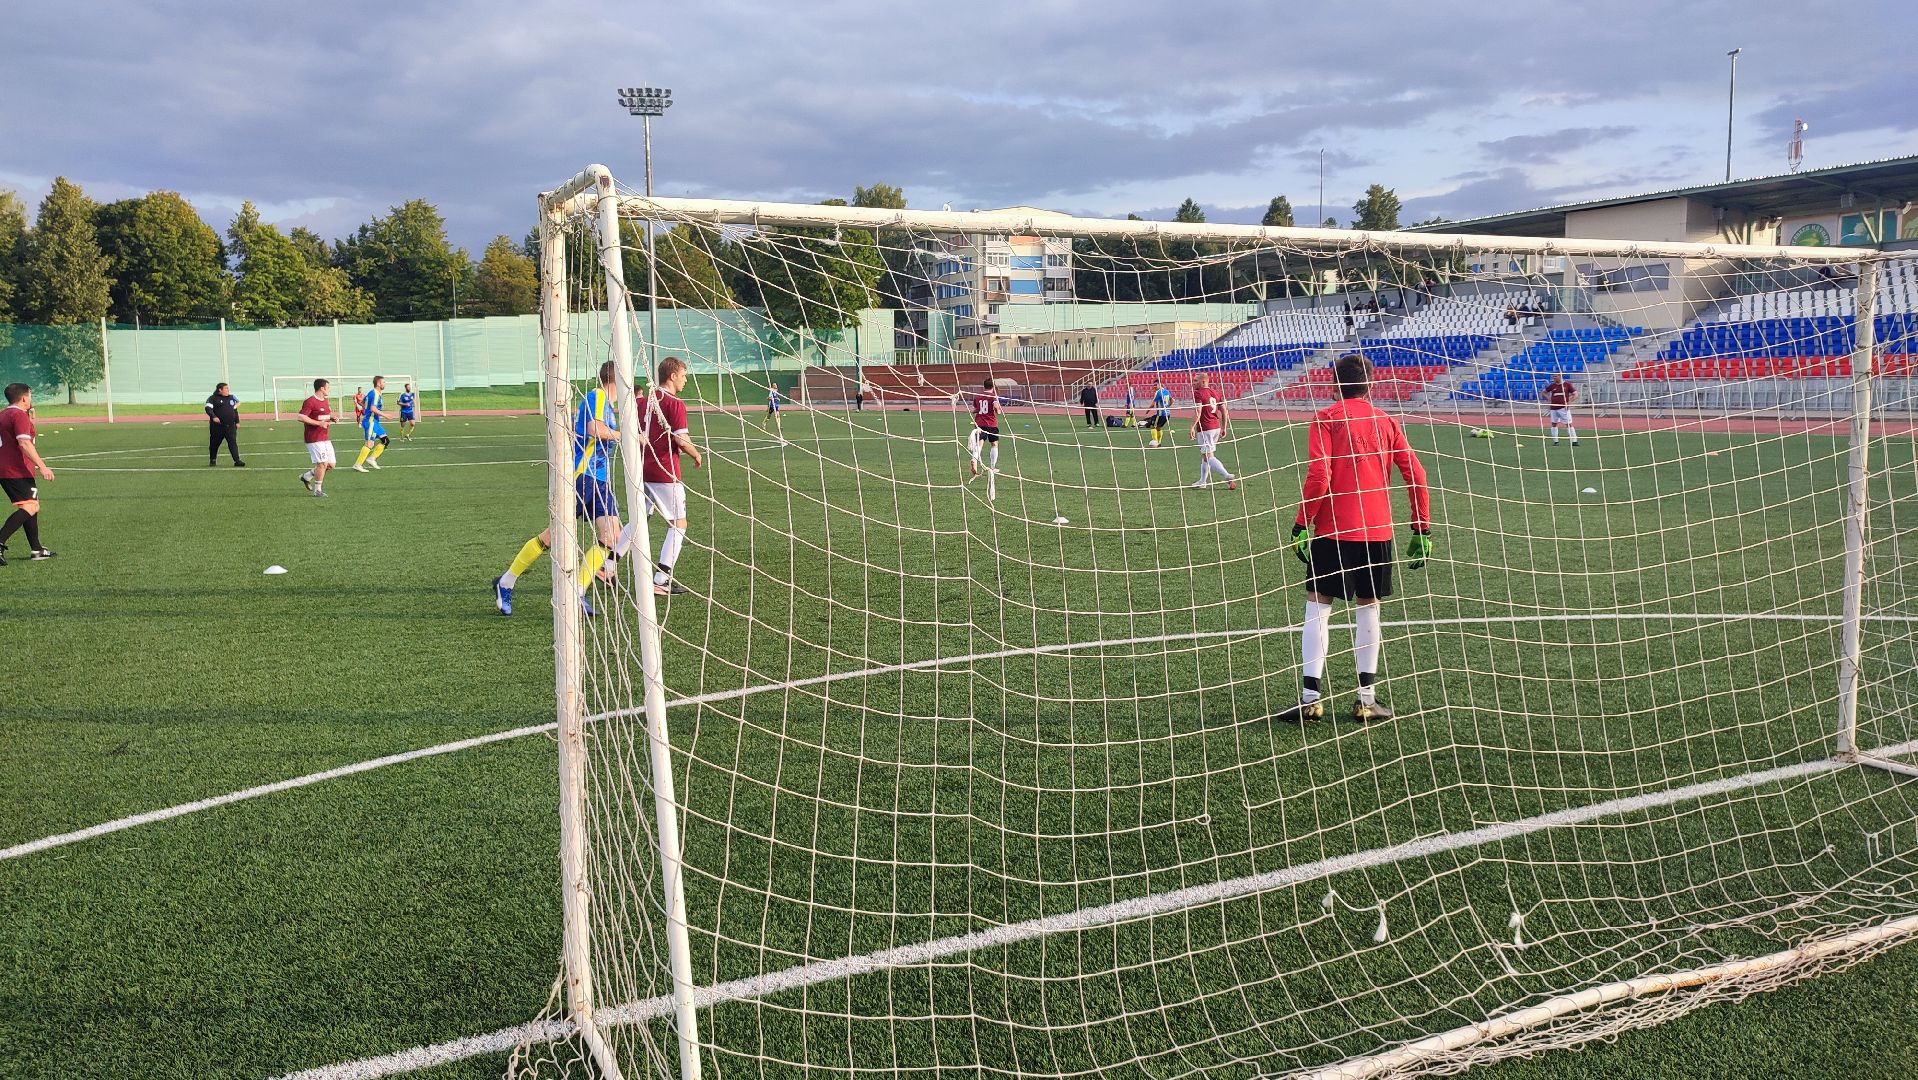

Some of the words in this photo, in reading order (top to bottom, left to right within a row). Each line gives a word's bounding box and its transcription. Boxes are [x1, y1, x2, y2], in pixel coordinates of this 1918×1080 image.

[979, 400, 989, 414] 18
[1209, 397, 1217, 413] 9
[30, 488, 38, 499] 7
